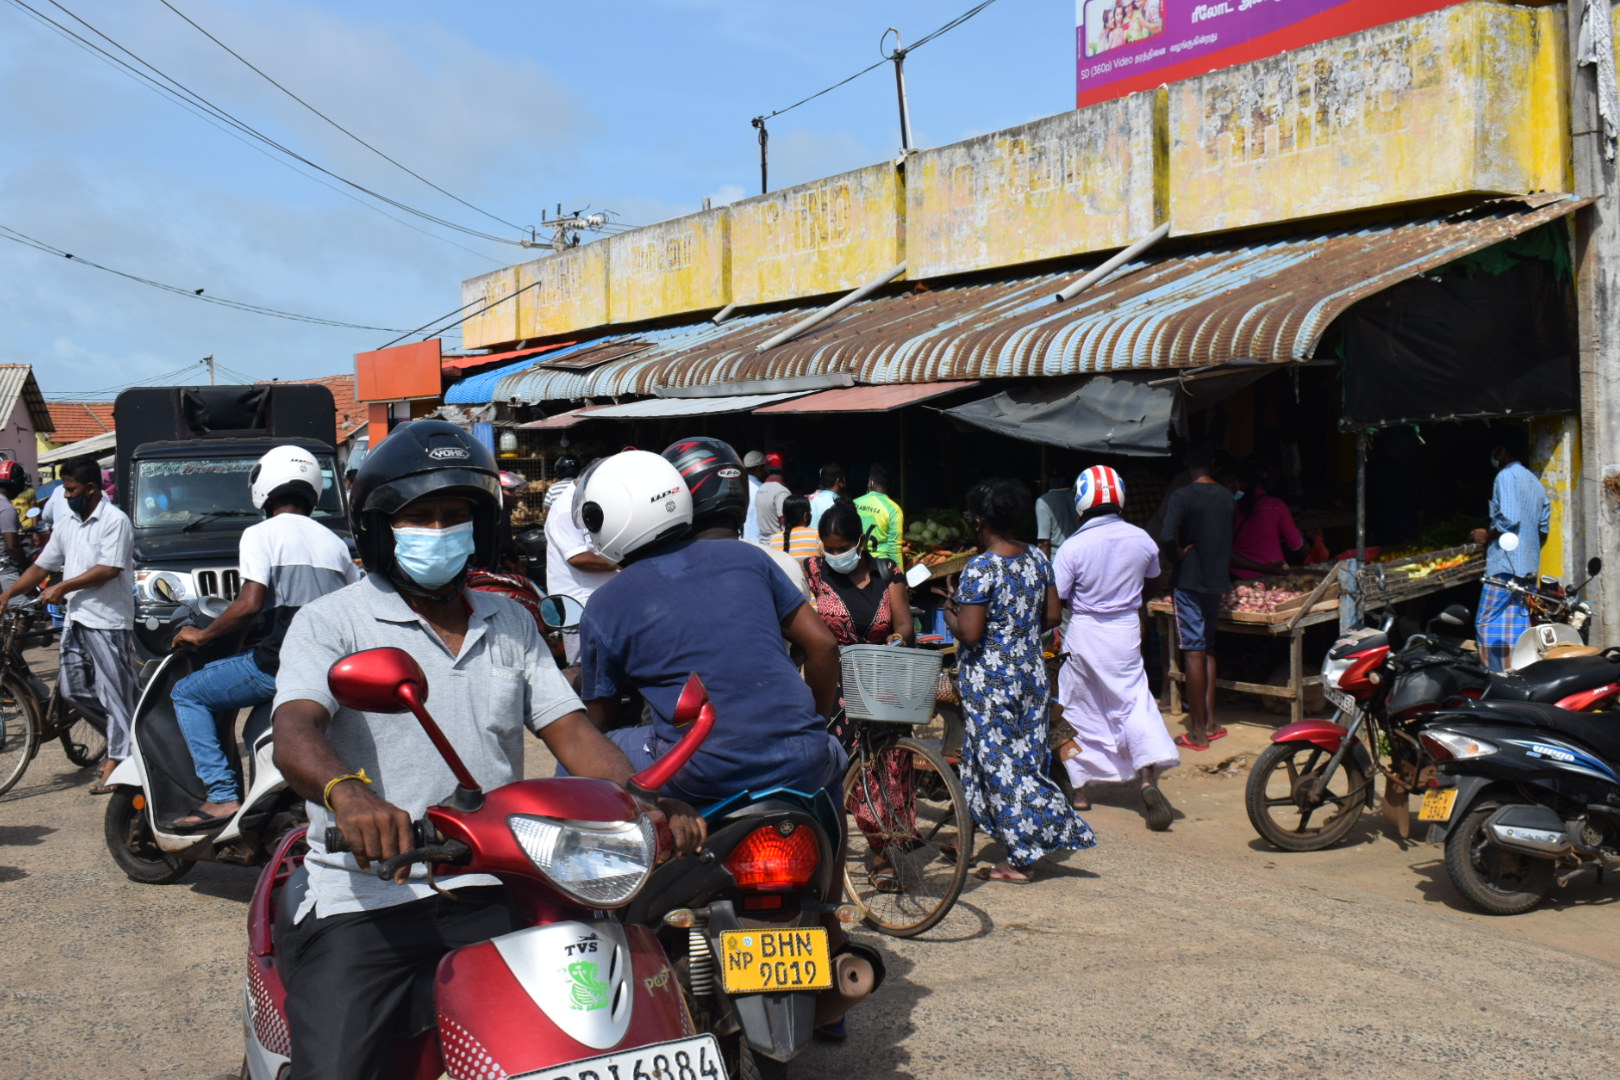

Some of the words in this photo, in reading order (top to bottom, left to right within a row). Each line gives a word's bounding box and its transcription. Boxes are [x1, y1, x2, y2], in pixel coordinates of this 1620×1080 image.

[1080, 68, 1090, 80] SD
[1113, 56, 1134, 69] Video
[433, 449, 466, 458] YOHE
[564, 942, 599, 956] TVS
[760, 932, 813, 958] BHN
[728, 951, 754, 971] NP
[759, 960, 817, 986] 9019
